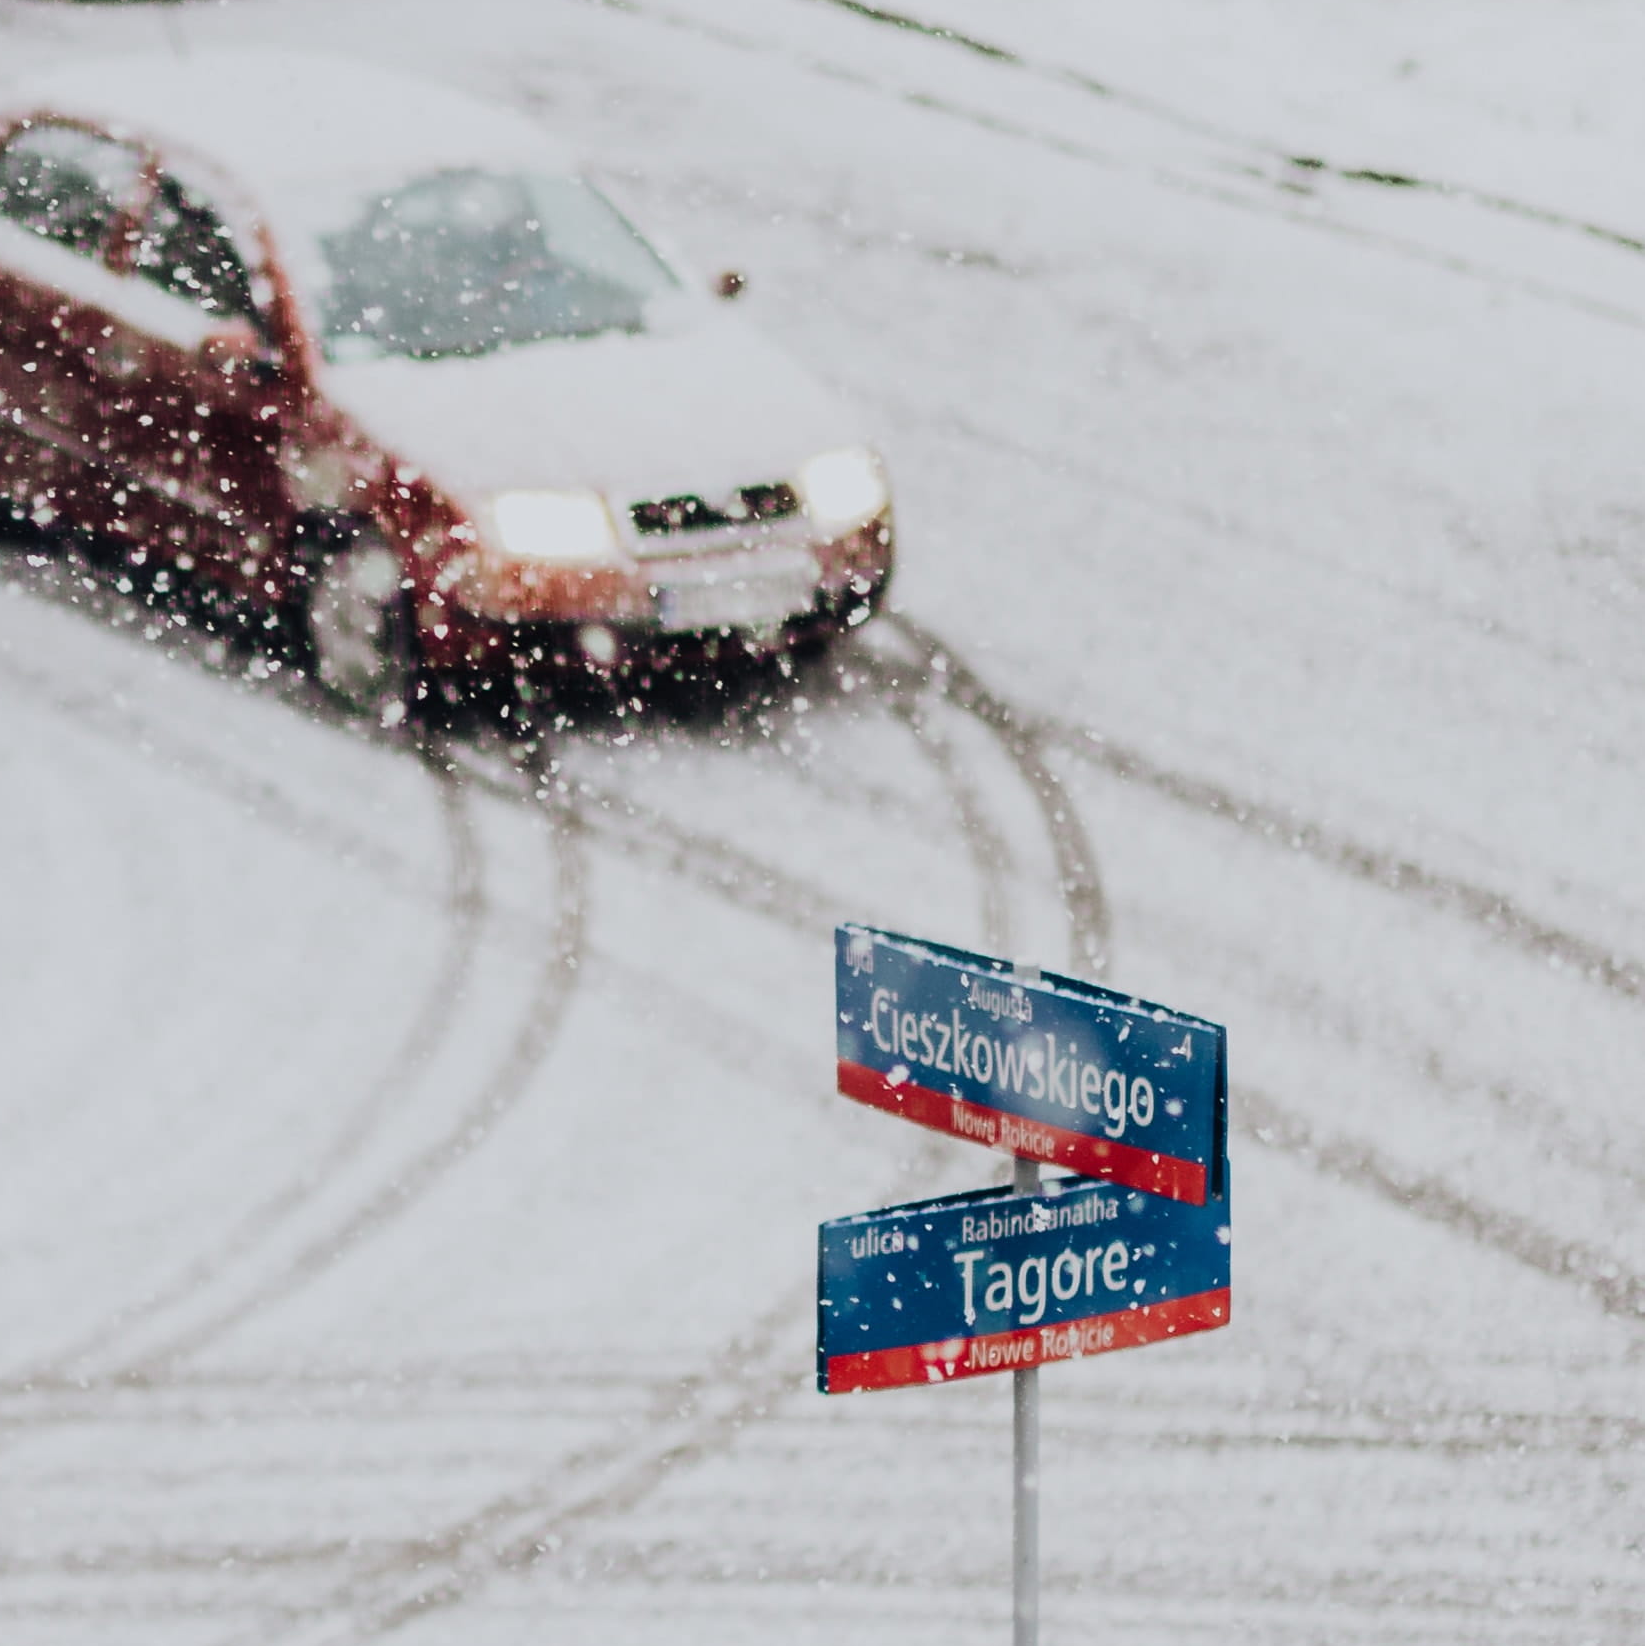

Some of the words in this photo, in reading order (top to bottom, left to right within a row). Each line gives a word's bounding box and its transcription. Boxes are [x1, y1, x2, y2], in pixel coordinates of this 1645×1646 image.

[969, 978, 1033, 1025] Augusta
[871, 987, 1154, 1136] Cieszkowskiego
[952, 1103, 995, 1144] Nowe
[1000, 1113, 1055, 1159] Rokicie
[852, 1229, 905, 1259] ulica
[962, 1192, 1119, 1244] Rabindanatha
[954, 1240, 1129, 1324] Tagore
[971, 1337, 1034, 1370] Nowe
